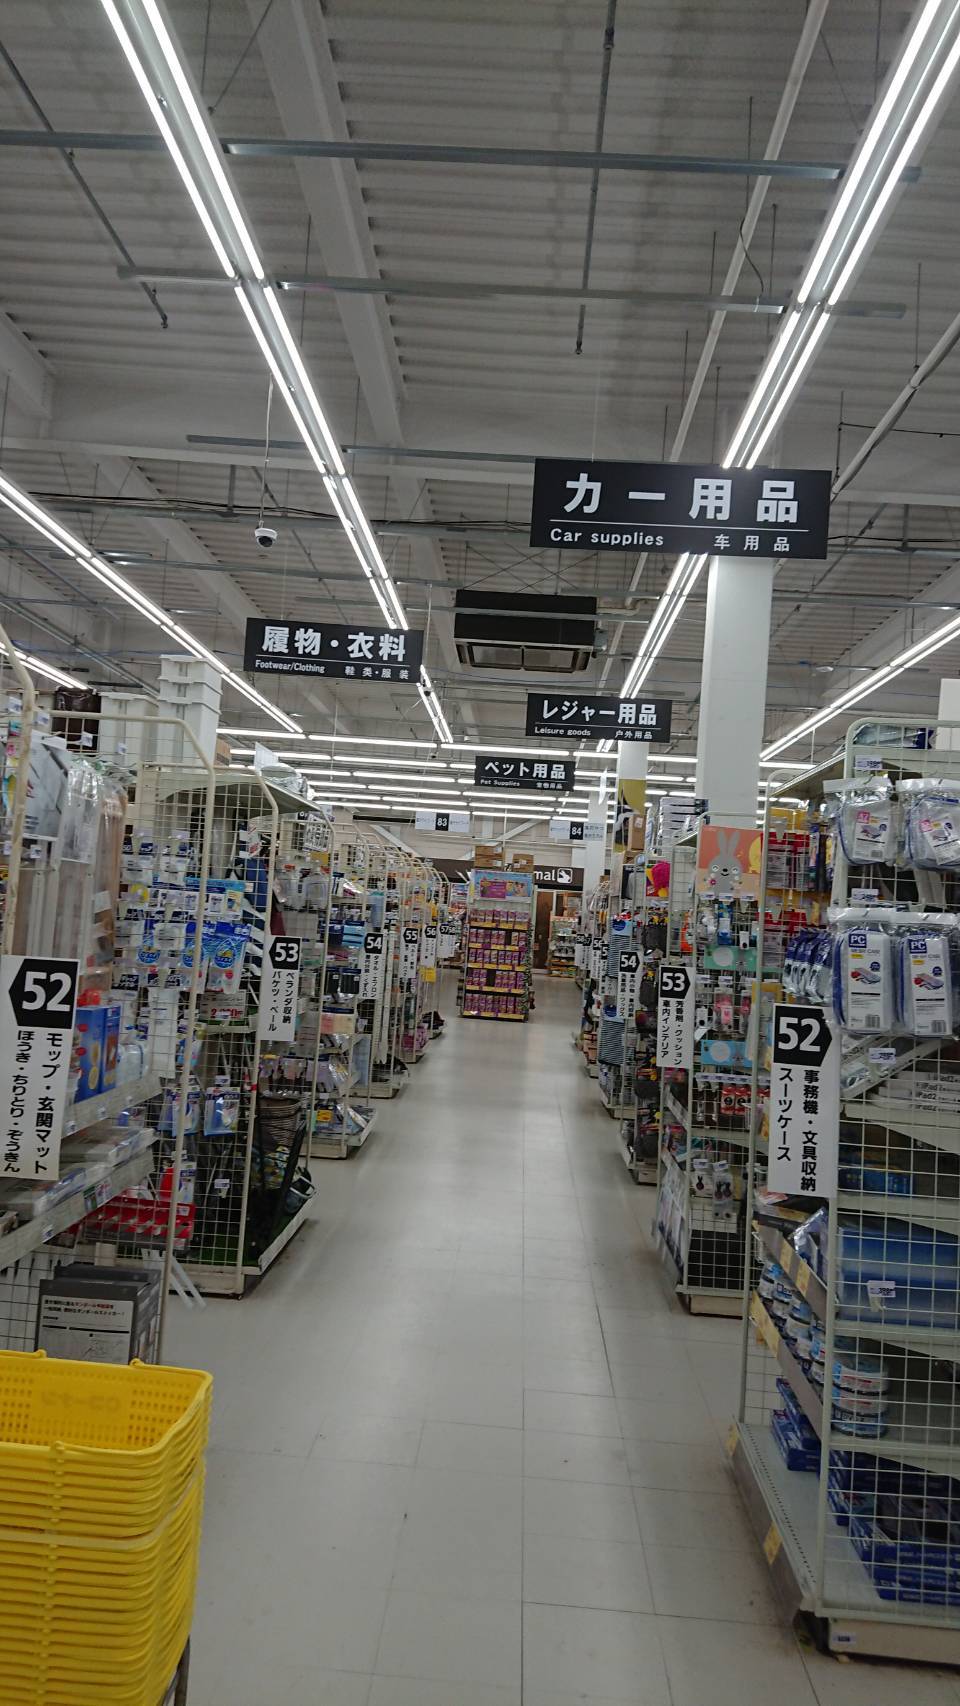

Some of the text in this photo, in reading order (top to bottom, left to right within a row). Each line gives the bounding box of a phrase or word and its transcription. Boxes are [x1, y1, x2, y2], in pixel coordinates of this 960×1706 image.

[563, 472, 799, 523] カー用品
[550, 528, 664, 546] Car supplies
[714, 534, 790, 552] 车用品
[262, 626, 407, 662] 履物・衣料
[256, 660, 325, 674] Footwear/Clothing
[542, 699, 658, 726] レジャー用品
[534, 726, 591, 738] Leisure goods
[484, 761, 566, 780] ペット用品
[436, 817, 448, 827] 83
[571, 827, 583, 836] 84
[405, 930, 418, 940] 55
[426, 927, 436, 935] 56
[850, 935, 866, 944] PC
[274, 942, 299, 962] 53
[366, 936, 382, 949] 54
[911, 941, 925, 949] PC
[621, 955, 637, 968] 54
[21, 971, 73, 1012] 52
[661, 972, 686, 992] 53
[282, 971, 295, 1024] ベランダ収納
[661, 1000, 671, 1058] 車内インテリア
[777, 1016, 822, 1053] 52
[4, 1029, 35, 1174] ほうき・ちりとり・ぞうきん
[34, 1031, 64, 1175] モップ・玄関マット
[776, 1067, 794, 1162] スーツケース
[800, 1069, 820, 1192] 事務機・文具収納
